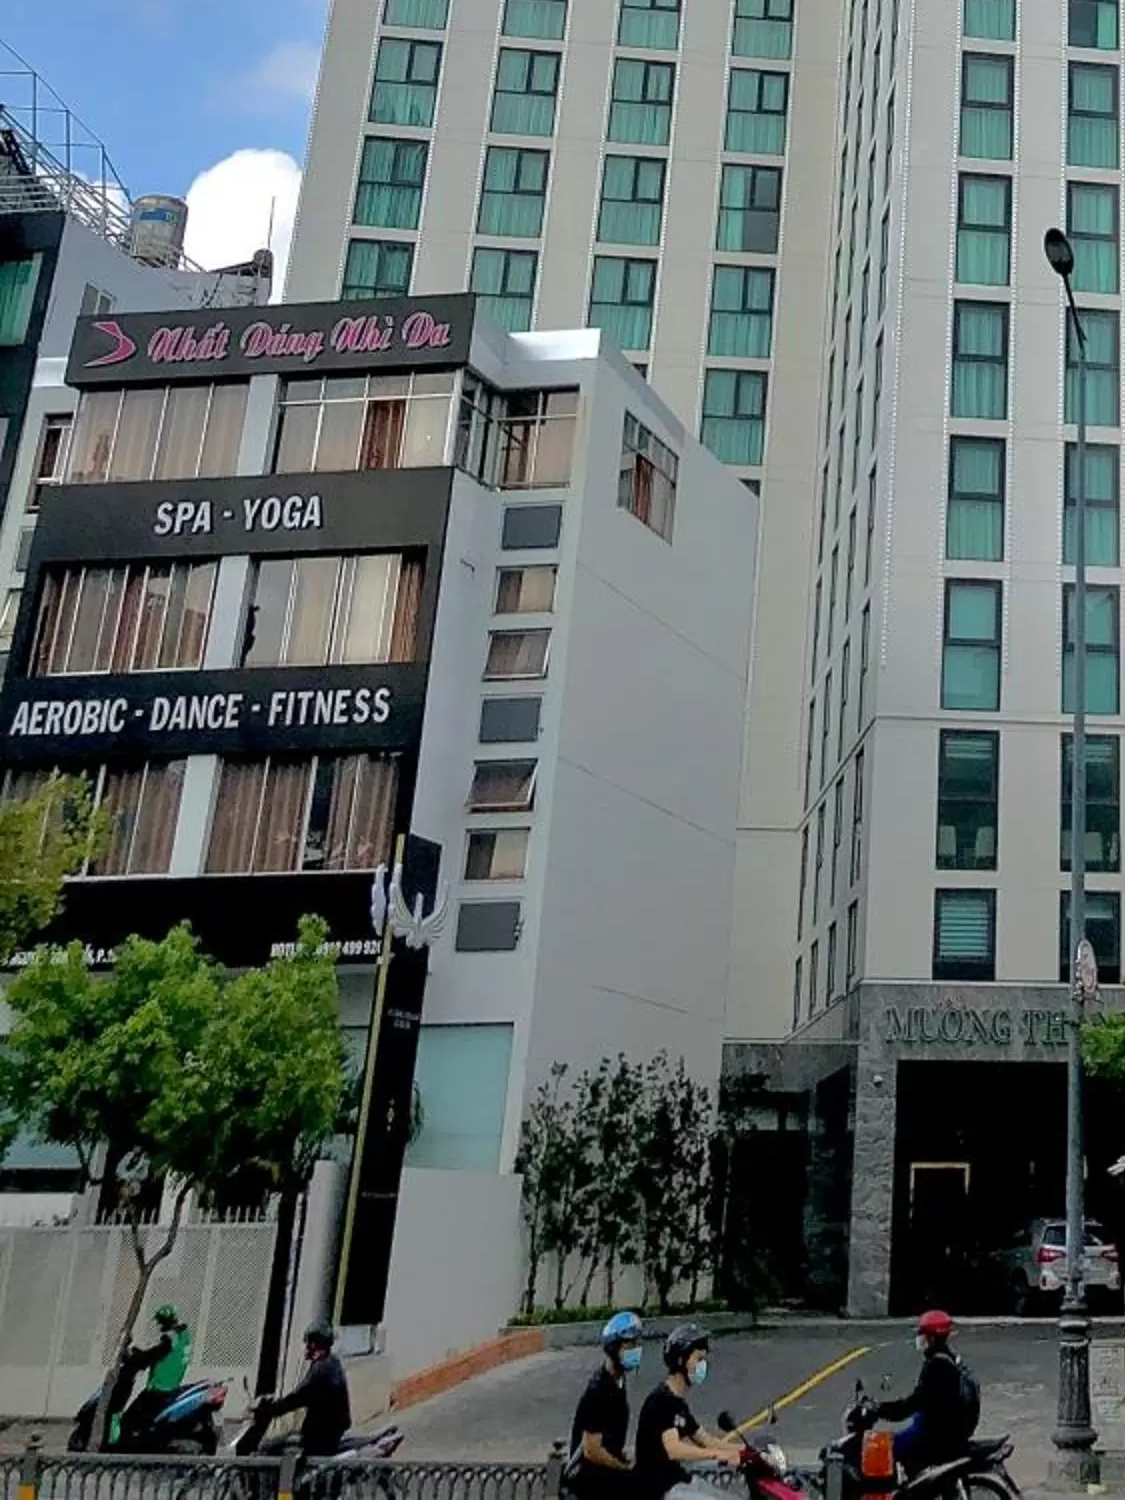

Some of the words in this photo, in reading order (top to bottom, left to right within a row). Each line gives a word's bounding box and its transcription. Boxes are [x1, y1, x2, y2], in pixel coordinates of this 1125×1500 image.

[154, 501, 213, 535] SPA
[244, 495, 323, 532] YOGA
[10, 699, 127, 736] AEROBIC
[150, 693, 243, 731] DANCE
[267, 687, 391, 727] FITNESS
